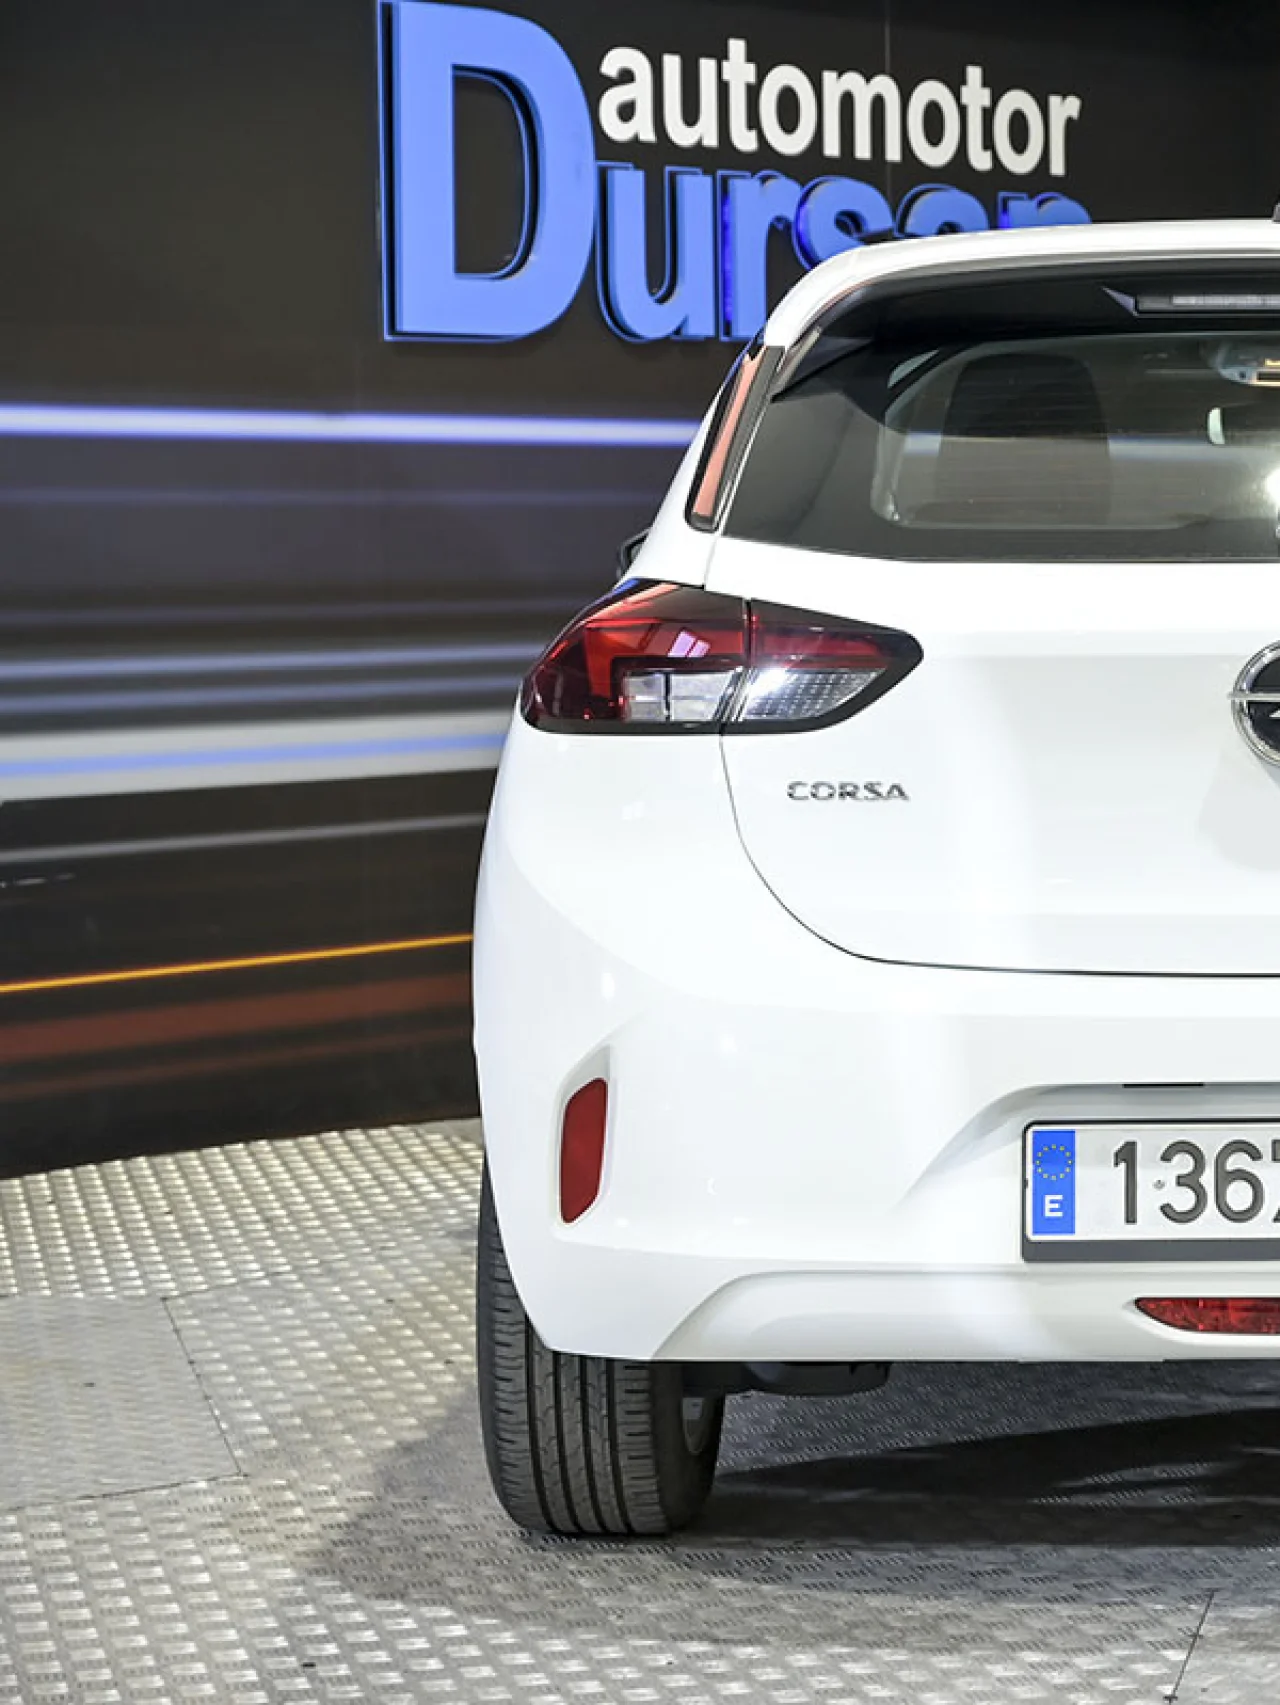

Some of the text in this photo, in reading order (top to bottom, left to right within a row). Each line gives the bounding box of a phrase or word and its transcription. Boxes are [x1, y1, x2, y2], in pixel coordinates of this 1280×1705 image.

[599, 38, 1081, 177] automotor
[378, 0, 1093, 343] Durs
[787, 780, 910, 802] CORSA
[1044, 1194, 1064, 1218] E
